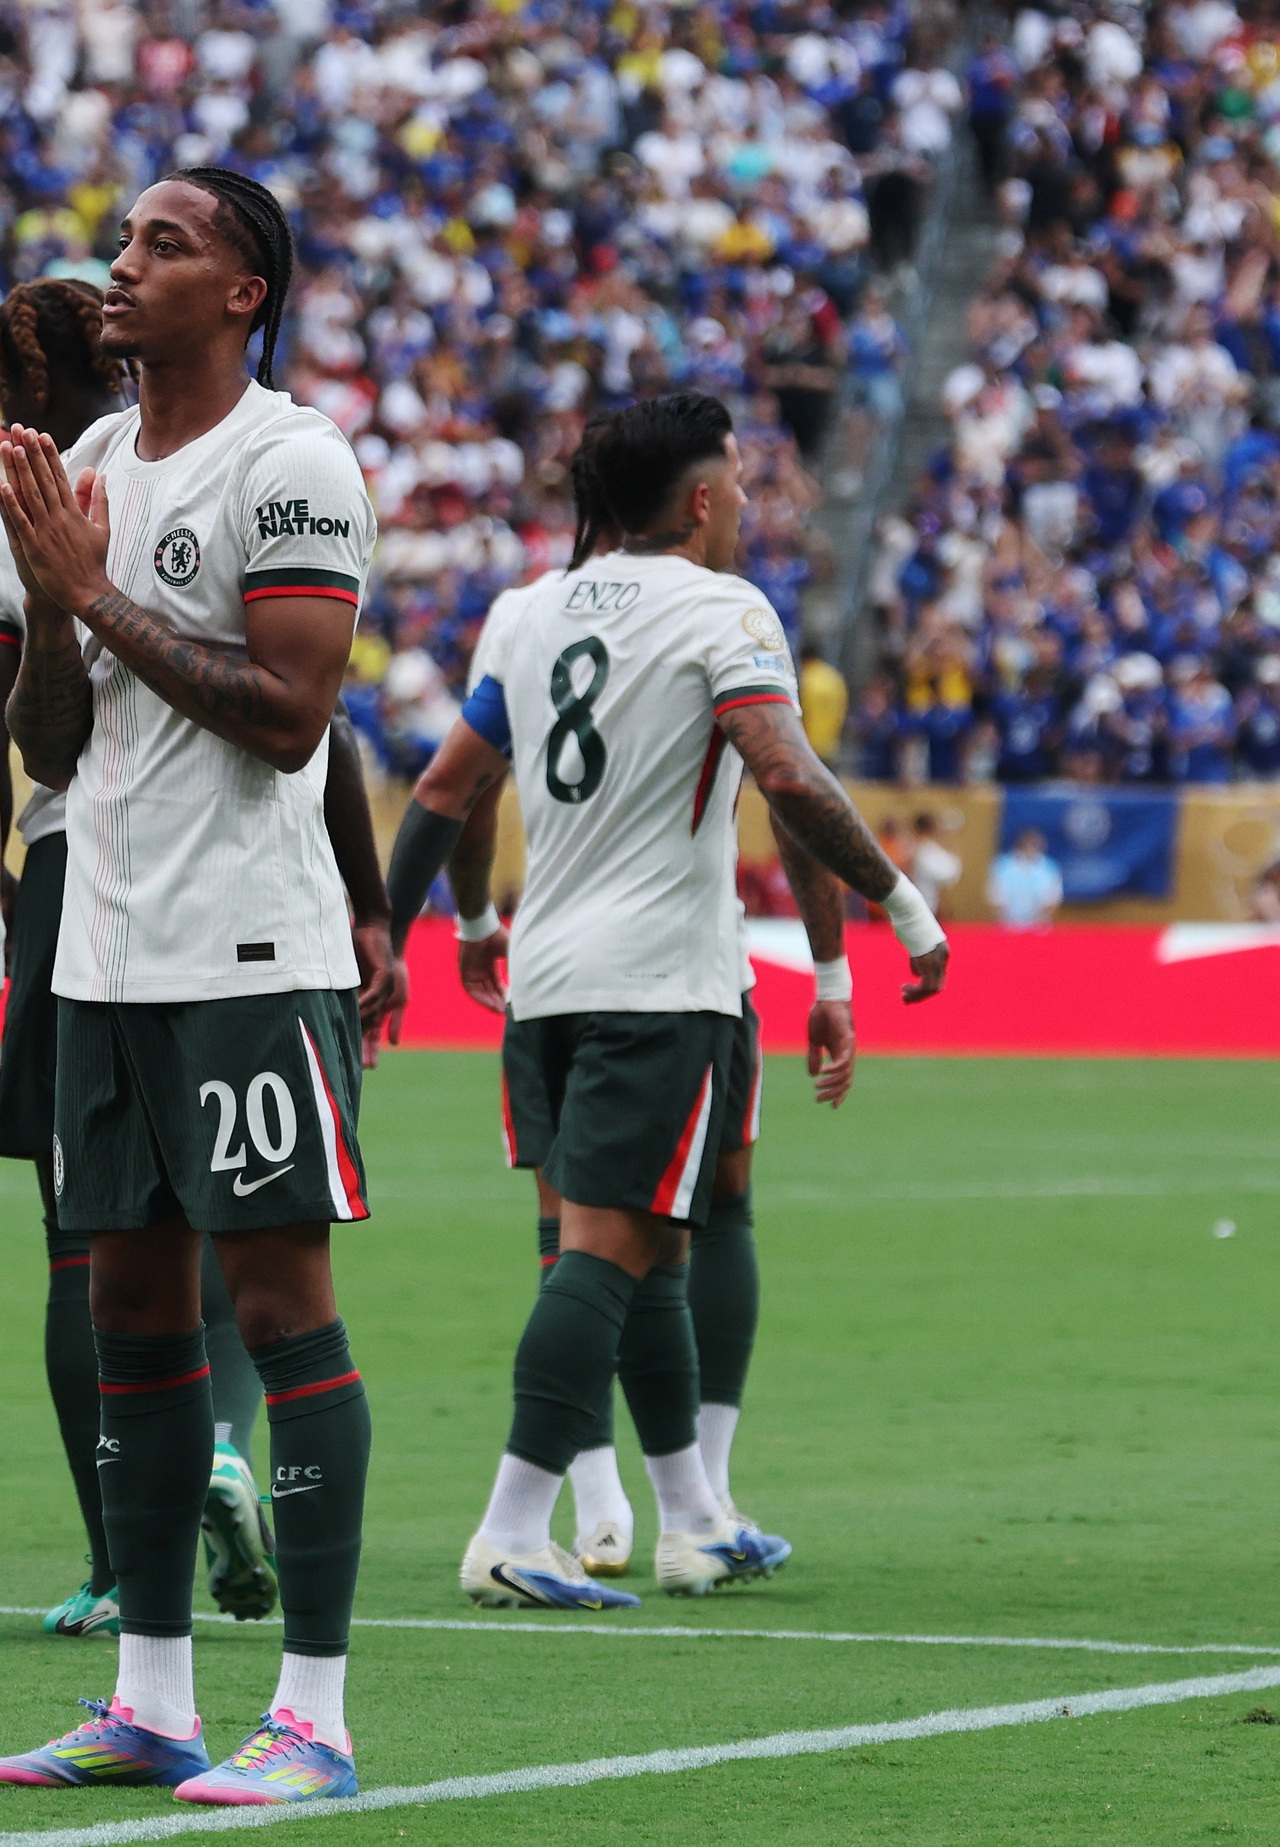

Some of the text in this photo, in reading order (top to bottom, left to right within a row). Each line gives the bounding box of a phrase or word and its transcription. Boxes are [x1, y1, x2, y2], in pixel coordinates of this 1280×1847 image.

[256, 499, 309, 522] LIVE
[165, 529, 195, 542] CHELSEA
[258, 517, 350, 540] NATION
[565, 581, 641, 610] ENZO
[546, 636, 609, 805] 8
[199, 1071, 297, 1172] 20
[96, 1434, 120, 1453] FC
[277, 1466, 322, 1480] CFC
